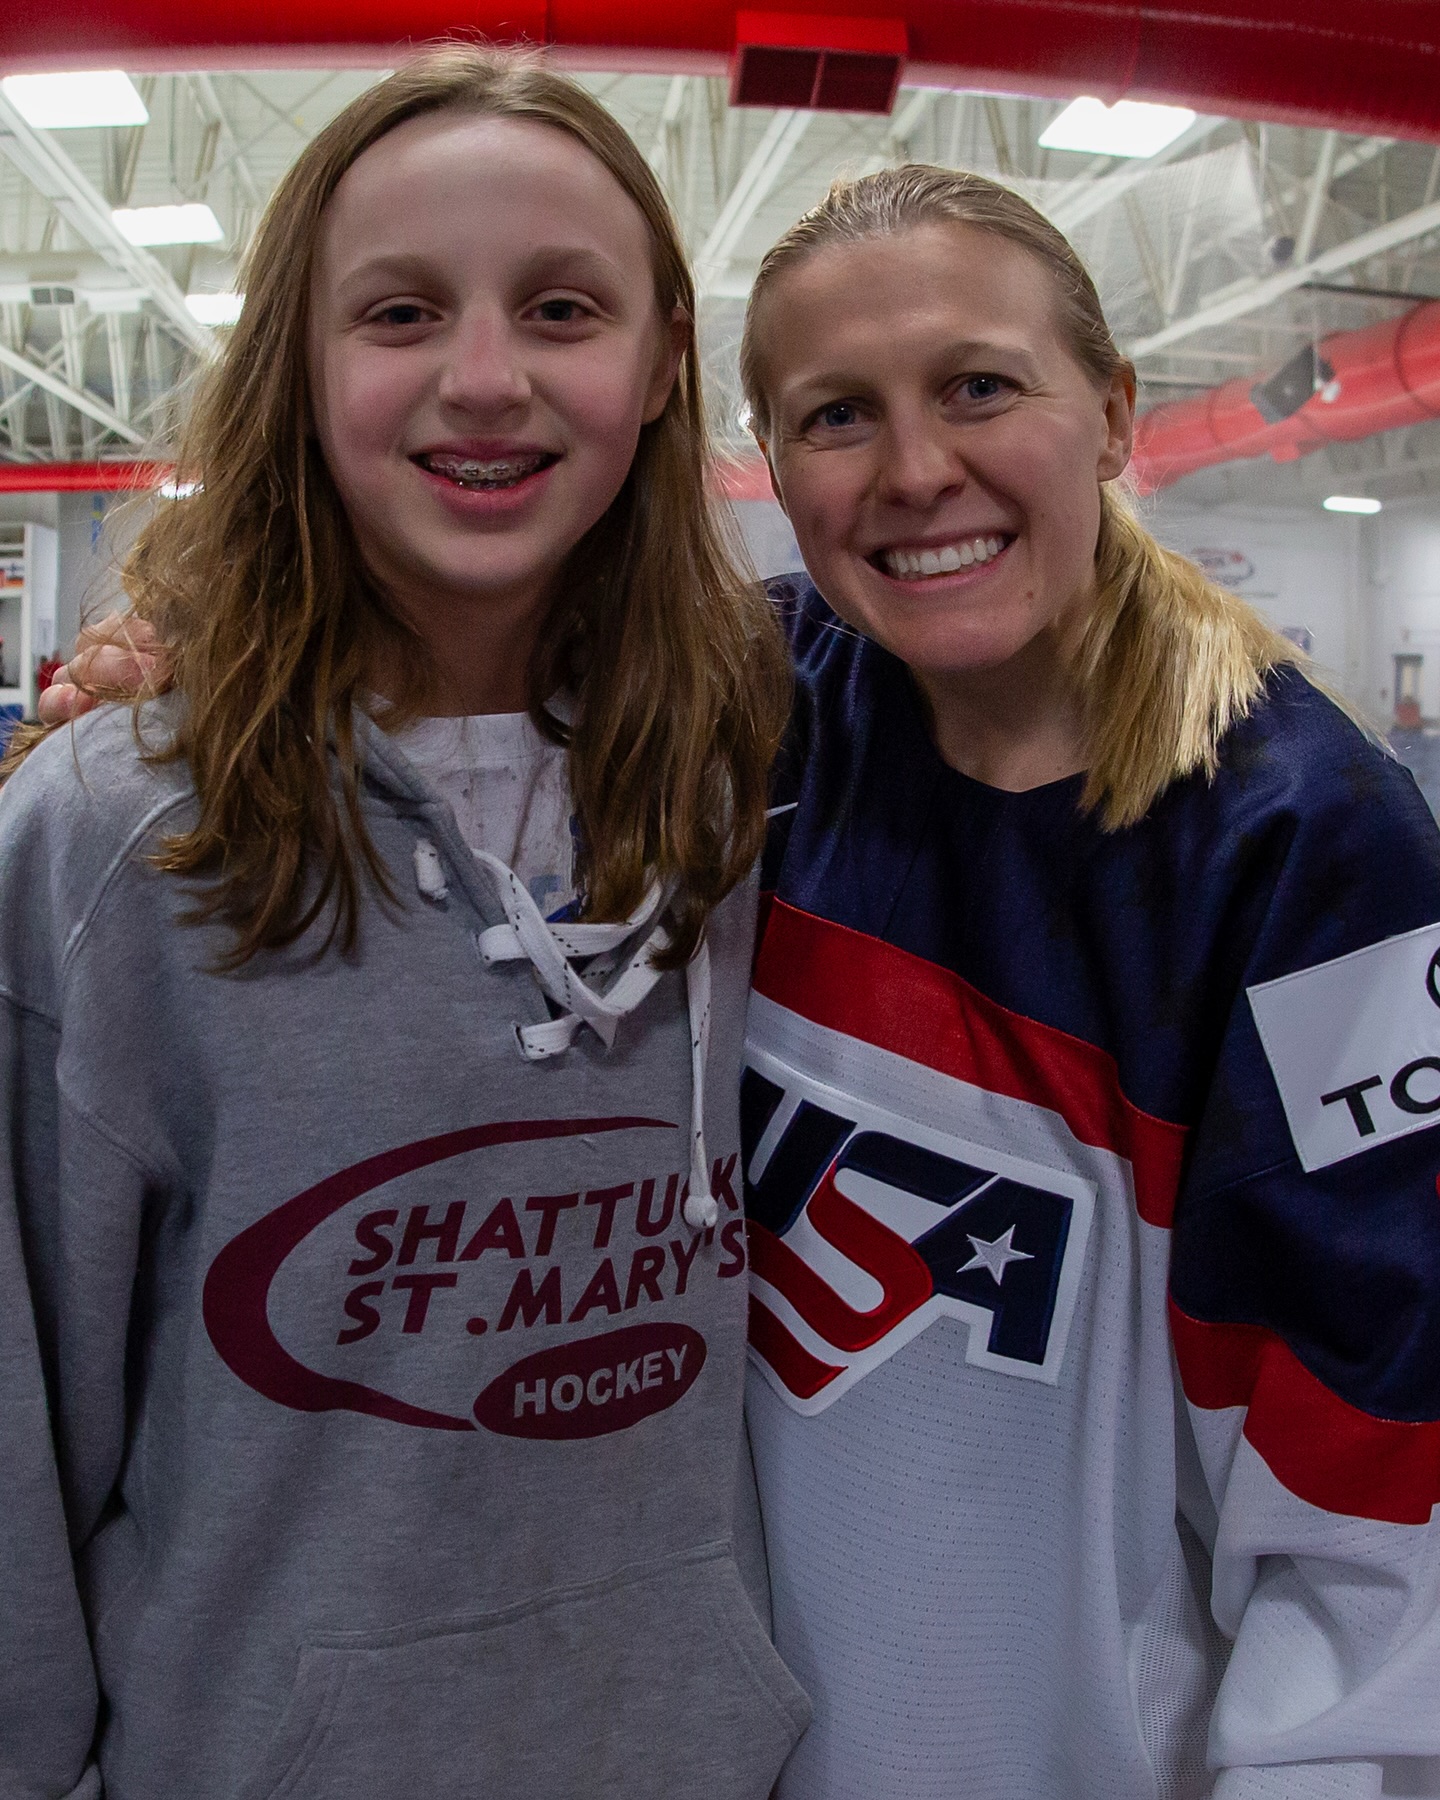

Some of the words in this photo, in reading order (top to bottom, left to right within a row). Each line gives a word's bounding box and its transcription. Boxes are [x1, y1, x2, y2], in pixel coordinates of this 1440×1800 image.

[496, 1218, 746, 1333] MARY'S
[740, 1065, 1075, 1400] USA
[513, 1343, 688, 1418] HOCKEY
